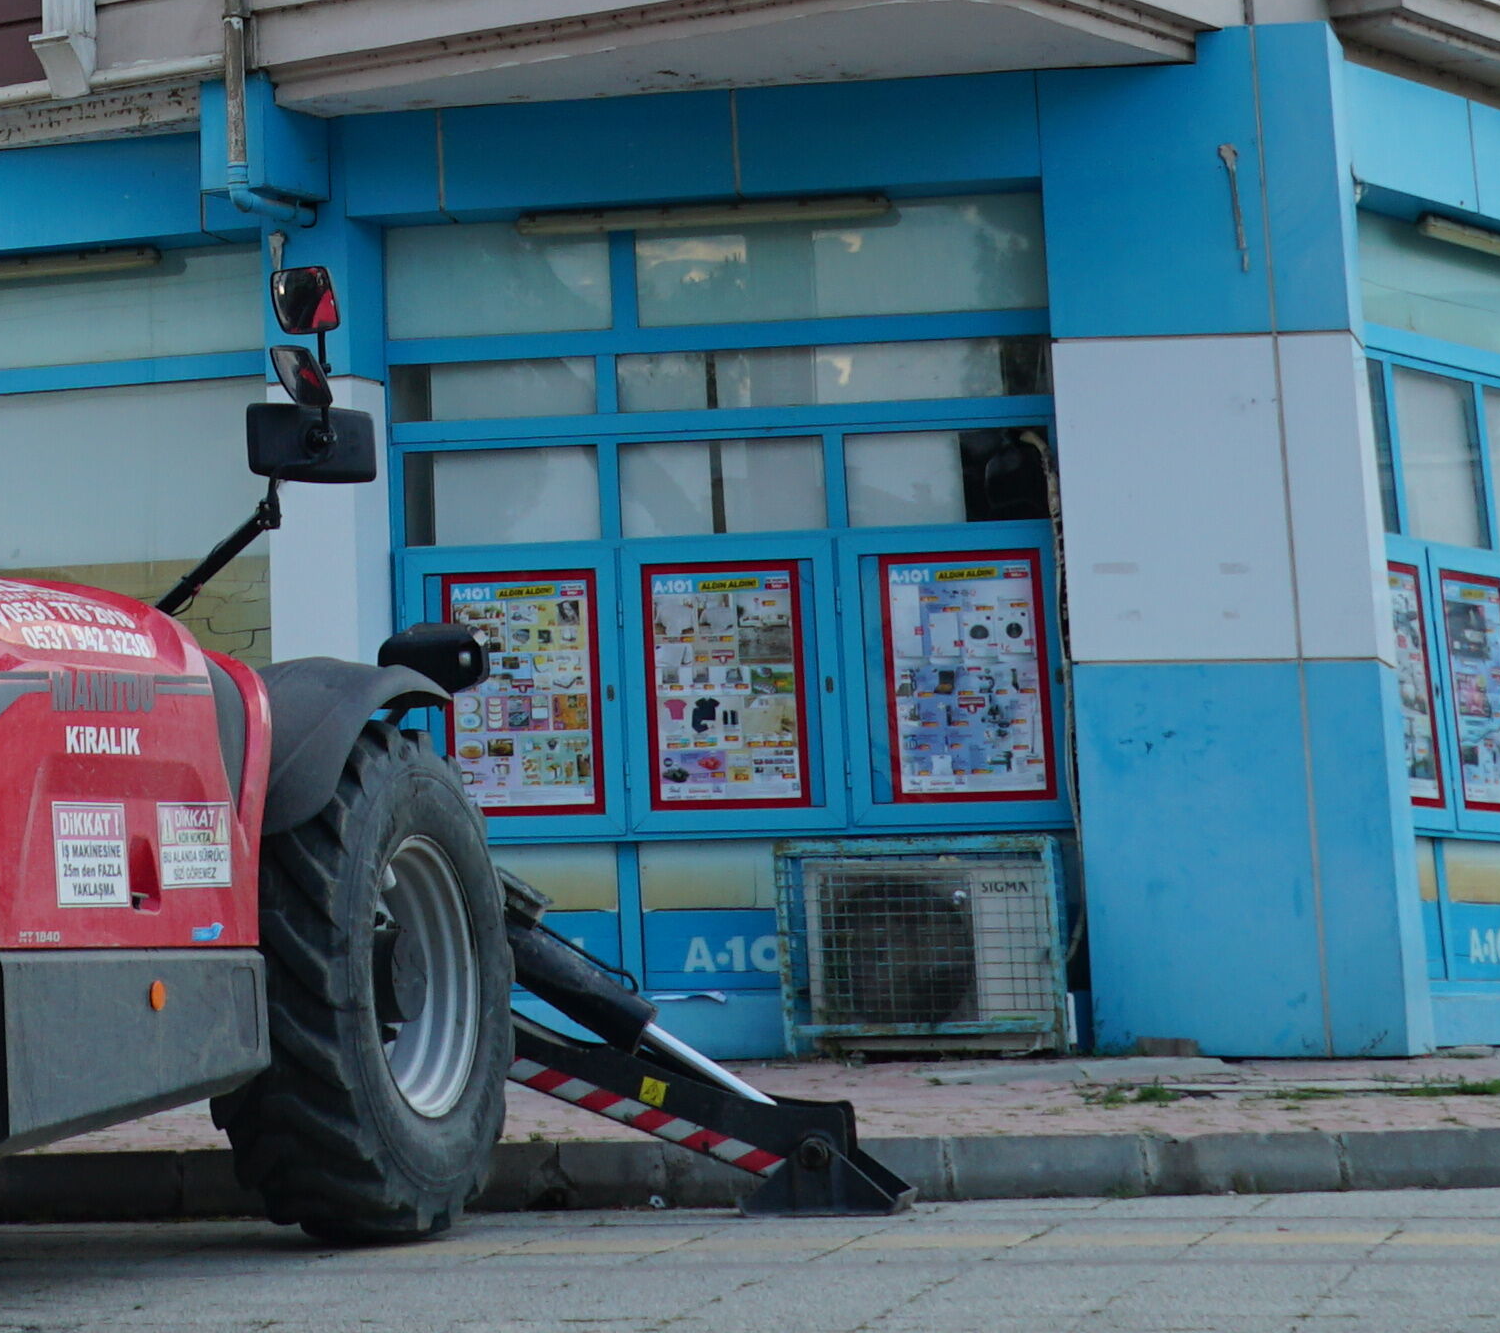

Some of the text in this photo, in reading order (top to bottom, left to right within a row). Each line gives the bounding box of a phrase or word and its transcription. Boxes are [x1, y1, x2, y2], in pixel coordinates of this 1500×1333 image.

[2, 601, 136, 629] 0531 776 2018
[21, 625, 150, 658] 0531 942 3238
[52, 670, 155, 712] MANITOU
[72, 841, 122, 859] MAKİNESİNE
[63, 863, 123, 878] 25m den FAZLA
[72, 883, 116, 900] YAKLAŞMA
[981, 880, 1029, 893] SIGMA
